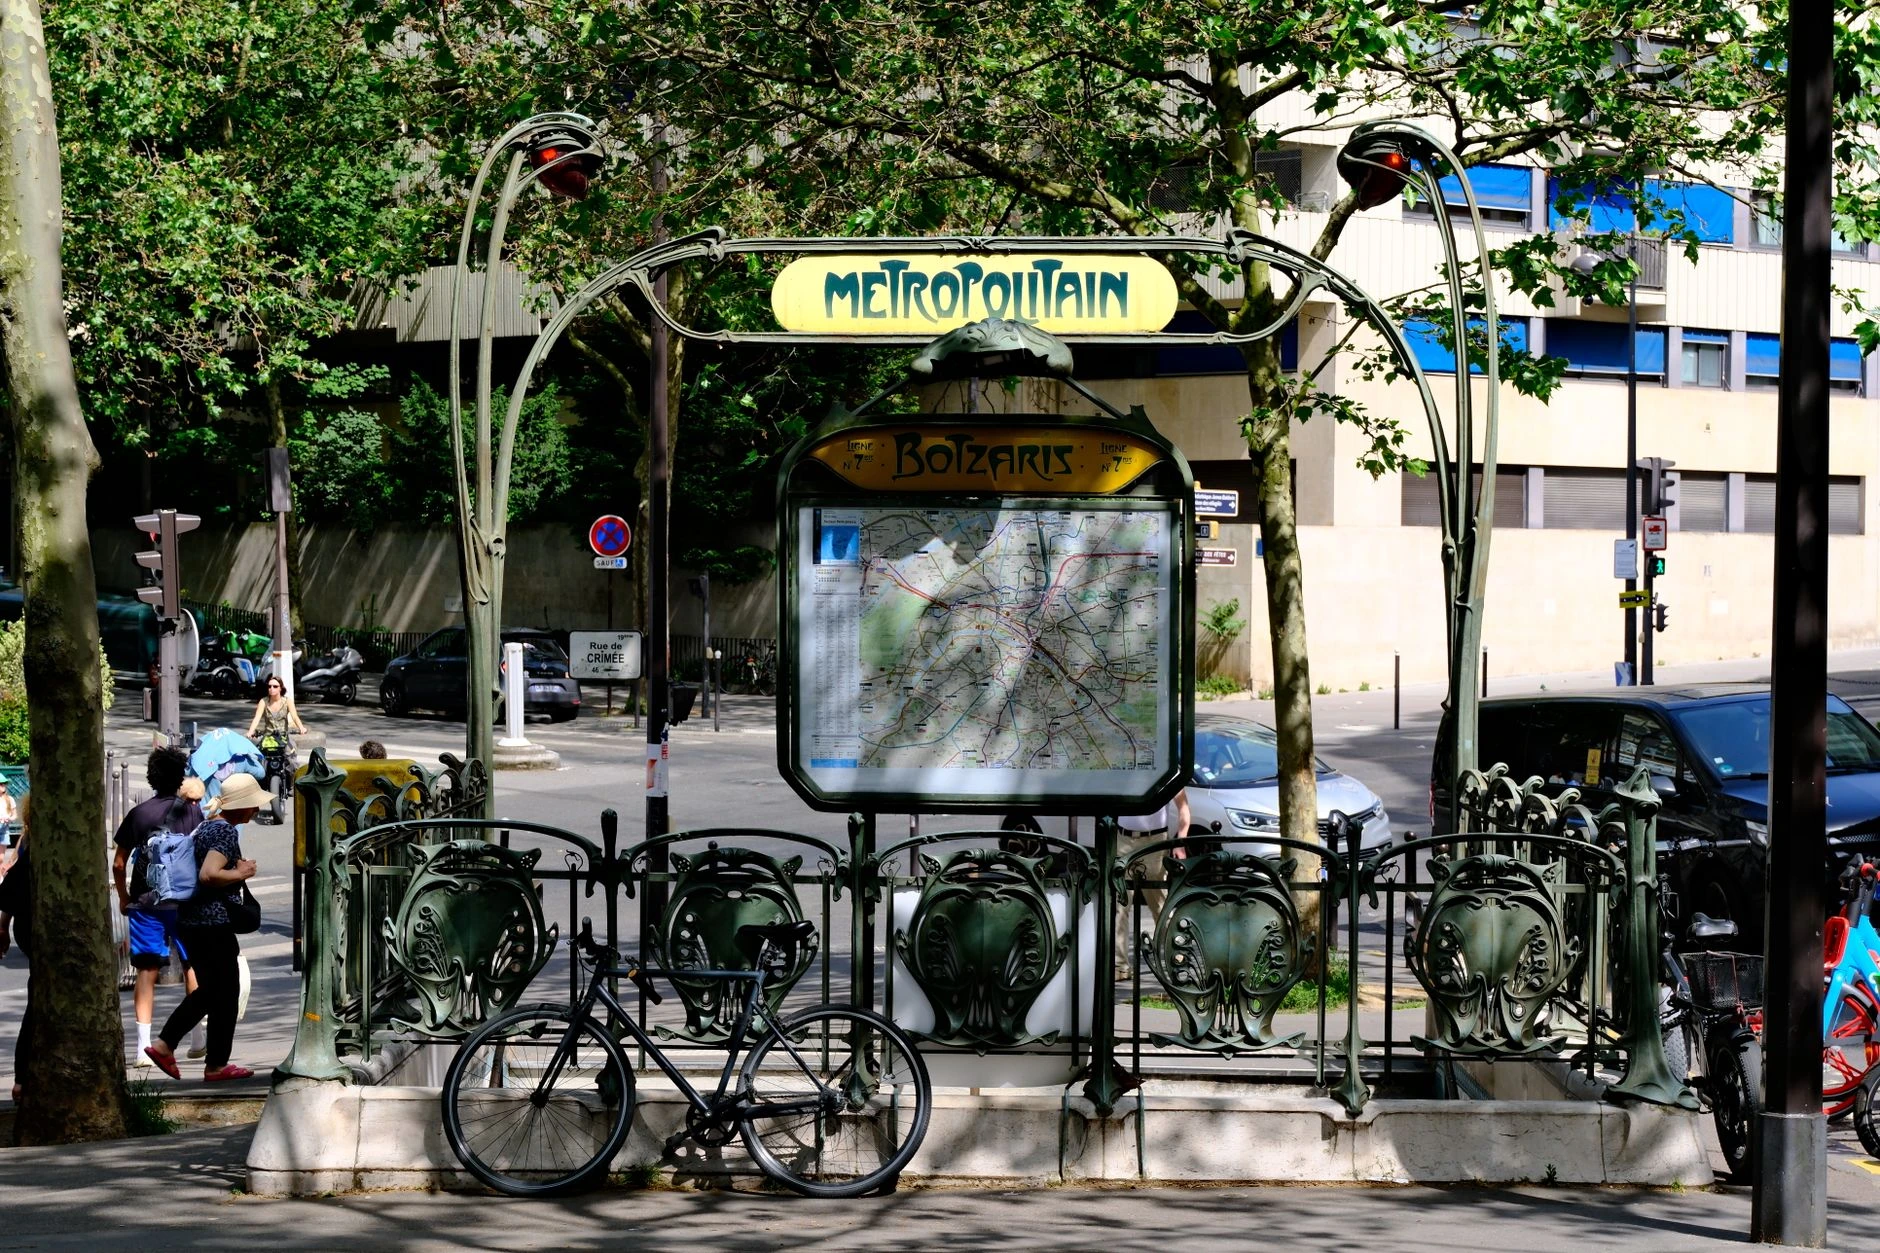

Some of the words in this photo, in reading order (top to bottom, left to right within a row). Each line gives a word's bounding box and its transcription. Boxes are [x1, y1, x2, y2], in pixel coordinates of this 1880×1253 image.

[824, 258, 1129, 324] METROPOLITAIN
[891, 432, 1074, 481] BOTZARIS
[595, 559, 615, 567] SAUF
[589, 642, 609, 650] Rue
[611, 642, 623, 650] de
[586, 651, 625, 664] CRIMÉE
